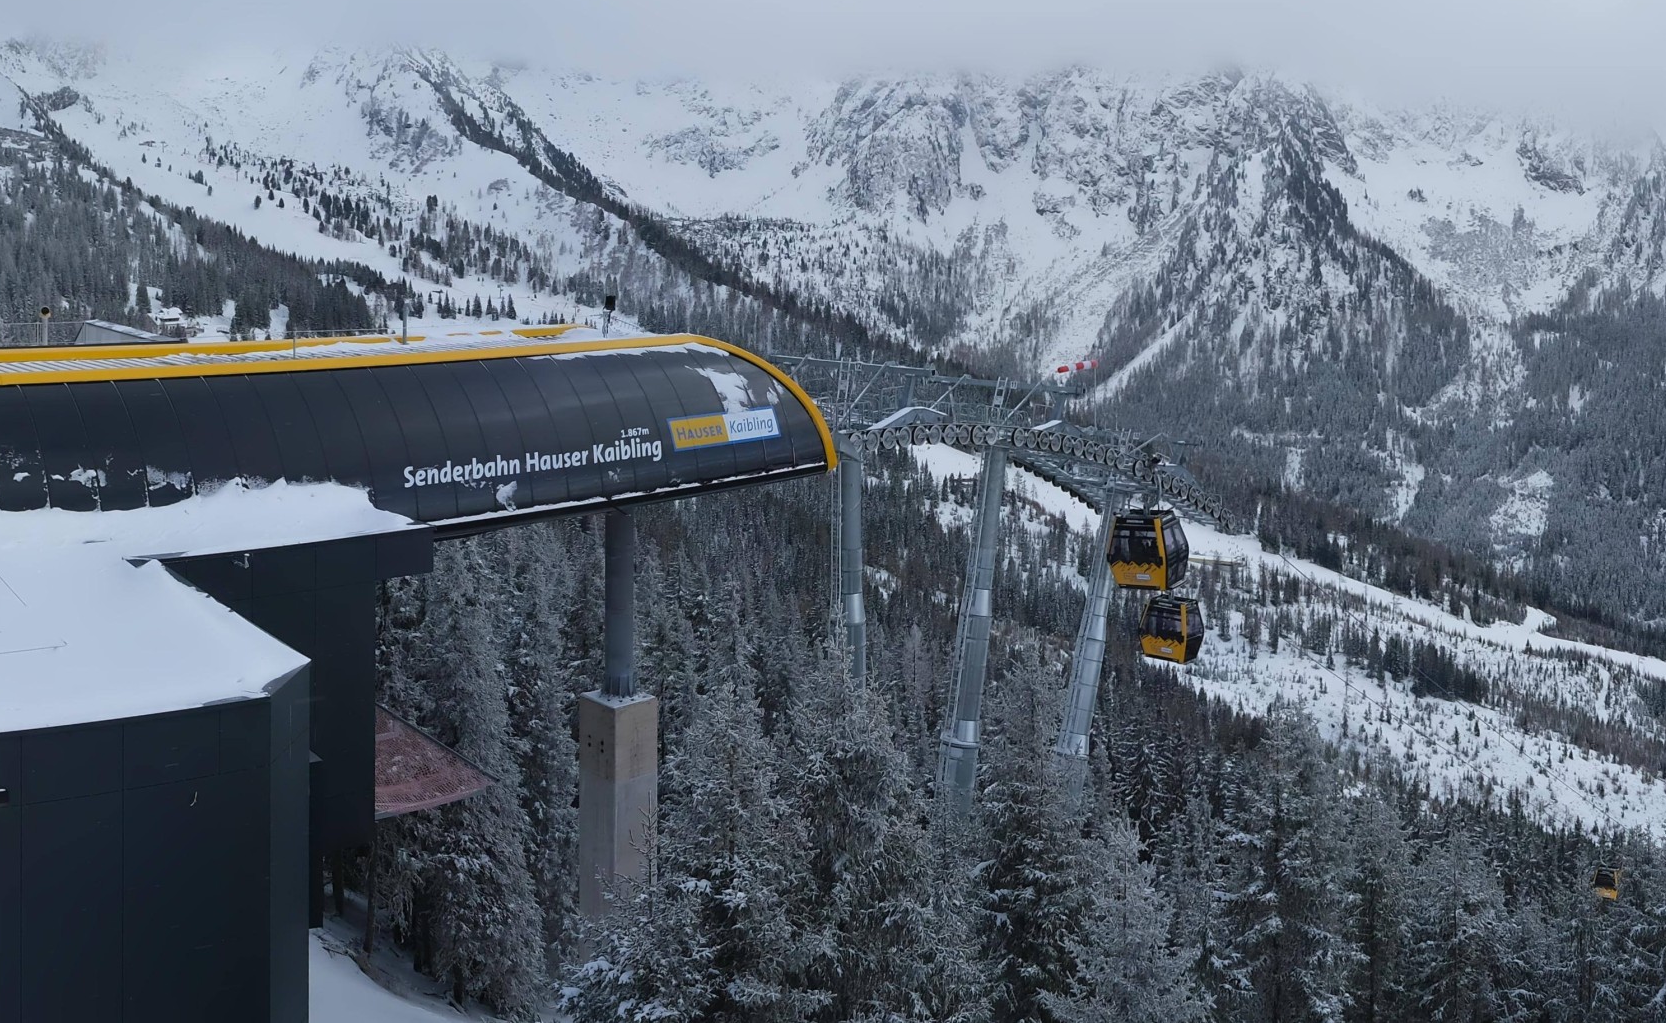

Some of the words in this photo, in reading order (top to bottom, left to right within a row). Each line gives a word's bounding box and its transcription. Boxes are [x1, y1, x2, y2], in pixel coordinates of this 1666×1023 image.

[621, 427, 650, 439] 1.867m
[676, 425, 723, 441] HAUSER
[729, 417, 773, 433] Kaibling
[403, 454, 521, 489] Senderbahn
[525, 448, 589, 473] Hauser
[593, 438, 662, 463] Kaibling
